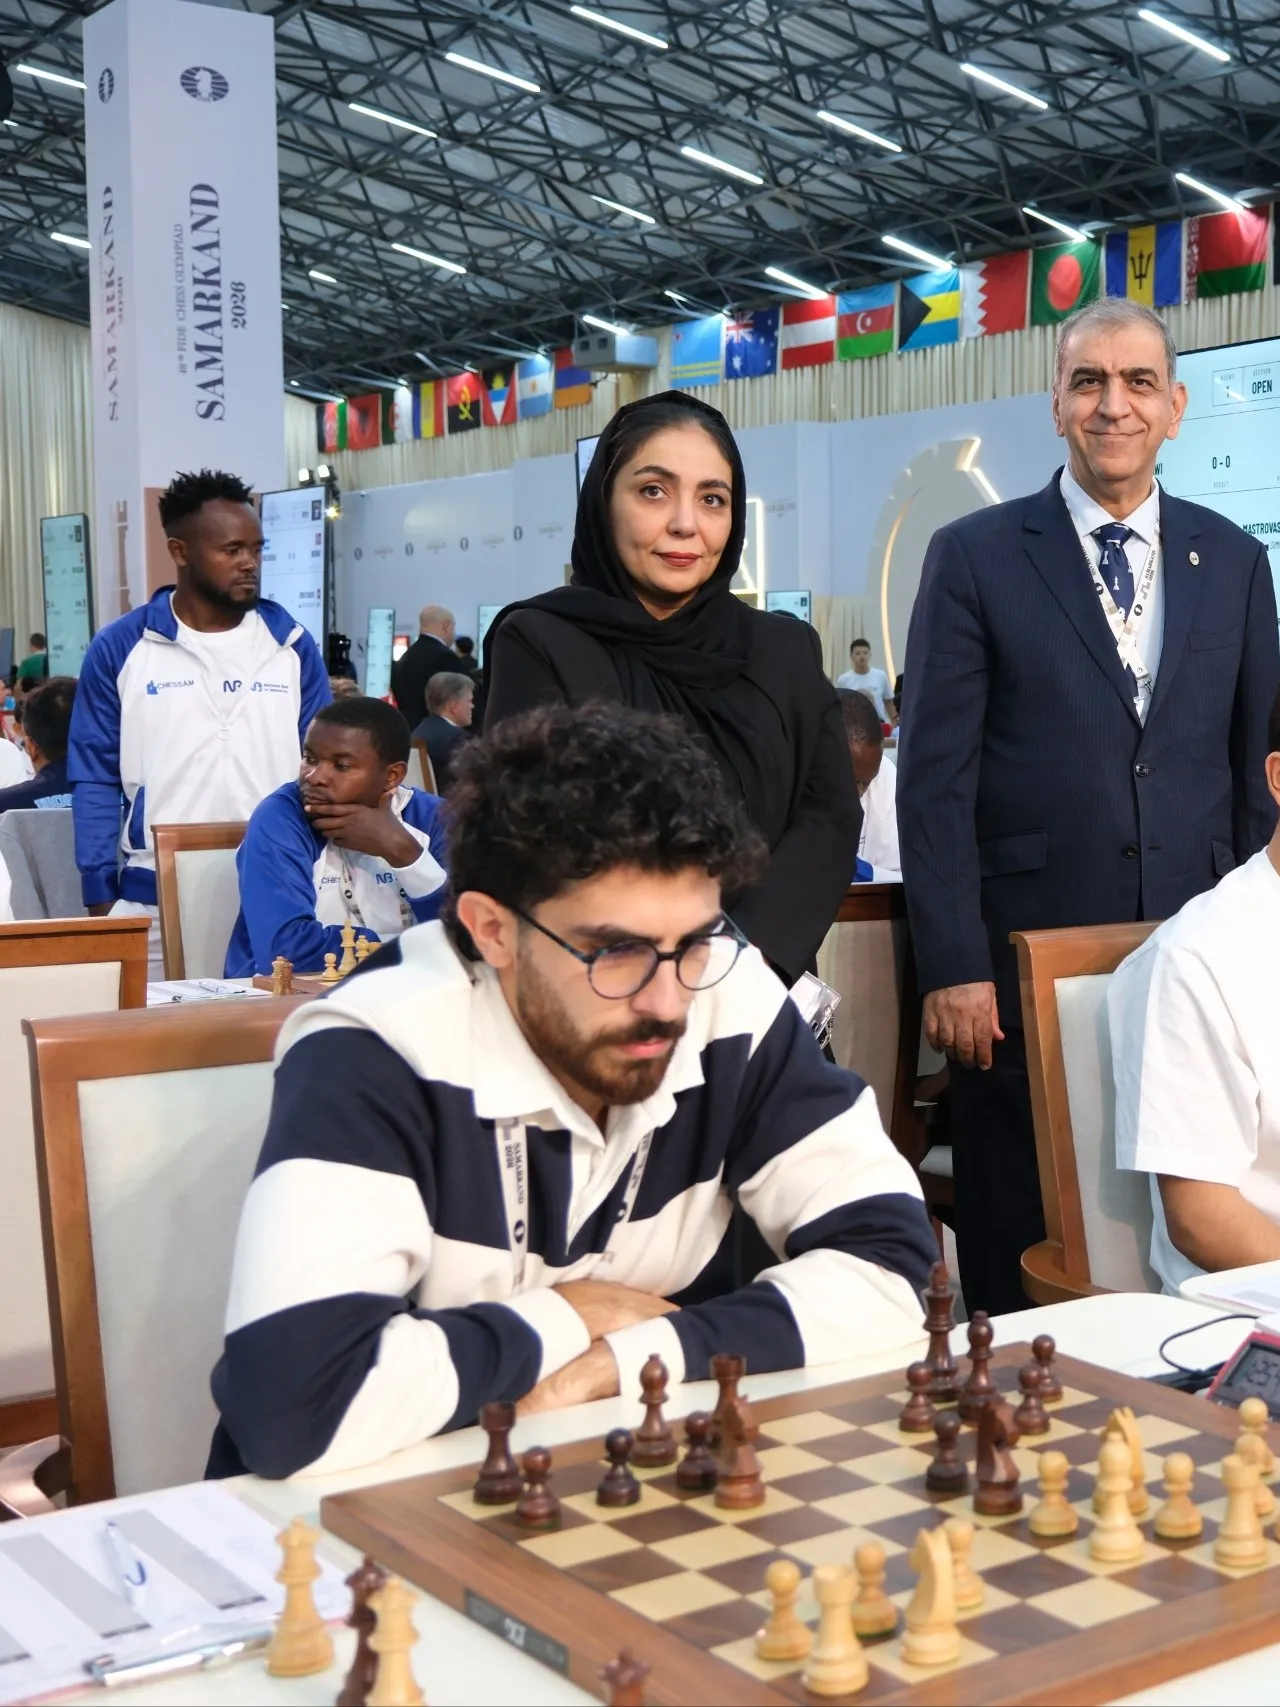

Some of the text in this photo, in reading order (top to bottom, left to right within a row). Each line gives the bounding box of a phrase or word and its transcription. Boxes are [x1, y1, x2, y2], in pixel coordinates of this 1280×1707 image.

[174, 223, 186, 283] OLYMPIAD
[103, 185, 119, 422] SAMARKAND
[176, 285, 187, 321] CHESS
[190, 183, 226, 421] SAMARKAND
[230, 281, 247, 330] 2026
[177, 325, 187, 352] FIDE
[1252, 379, 1273, 395] OPEN
[1144, 550, 1156, 579] SAMARKAND
[157, 679, 194, 690] CHESSAM
[513, 1142, 525, 1204] SAMARKAND
